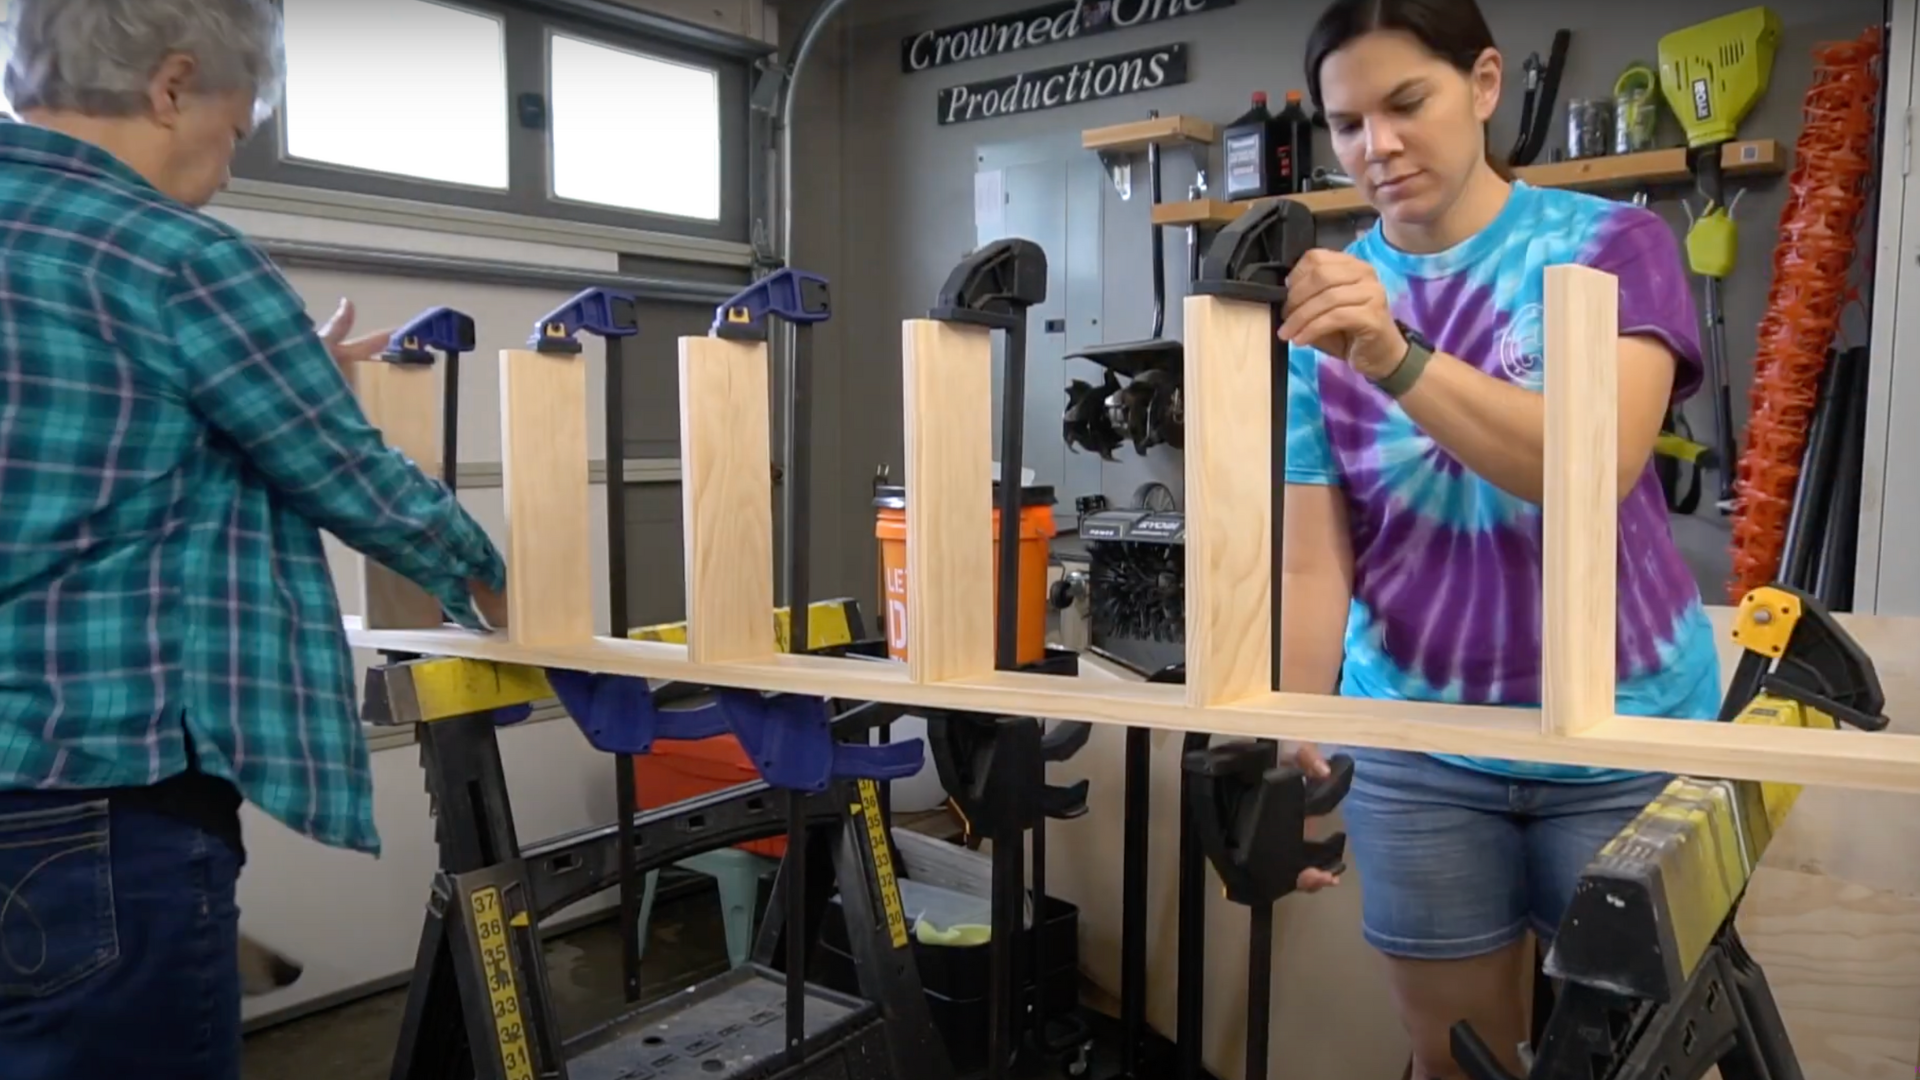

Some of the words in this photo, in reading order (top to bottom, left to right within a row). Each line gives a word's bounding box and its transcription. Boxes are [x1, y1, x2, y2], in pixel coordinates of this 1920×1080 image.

[909, 0, 1084, 71] Crowned
[944, 50, 1170, 123] Productions
[887, 567, 907, 593] LE
[863, 797, 876, 810] 36
[867, 815, 881, 830] 35
[871, 834, 885, 849] 34
[876, 854, 889, 869] 33
[880, 873, 893, 888] 32
[473, 892, 495, 914] 37
[884, 892, 898, 907] 31
[479, 918, 501, 940] 36
[888, 912, 902, 927] 30
[484, 943, 507, 966] 35
[494, 997, 517, 1018] 33
[500, 1022, 523, 1044] 32
[505, 1046, 527, 1070] 31
